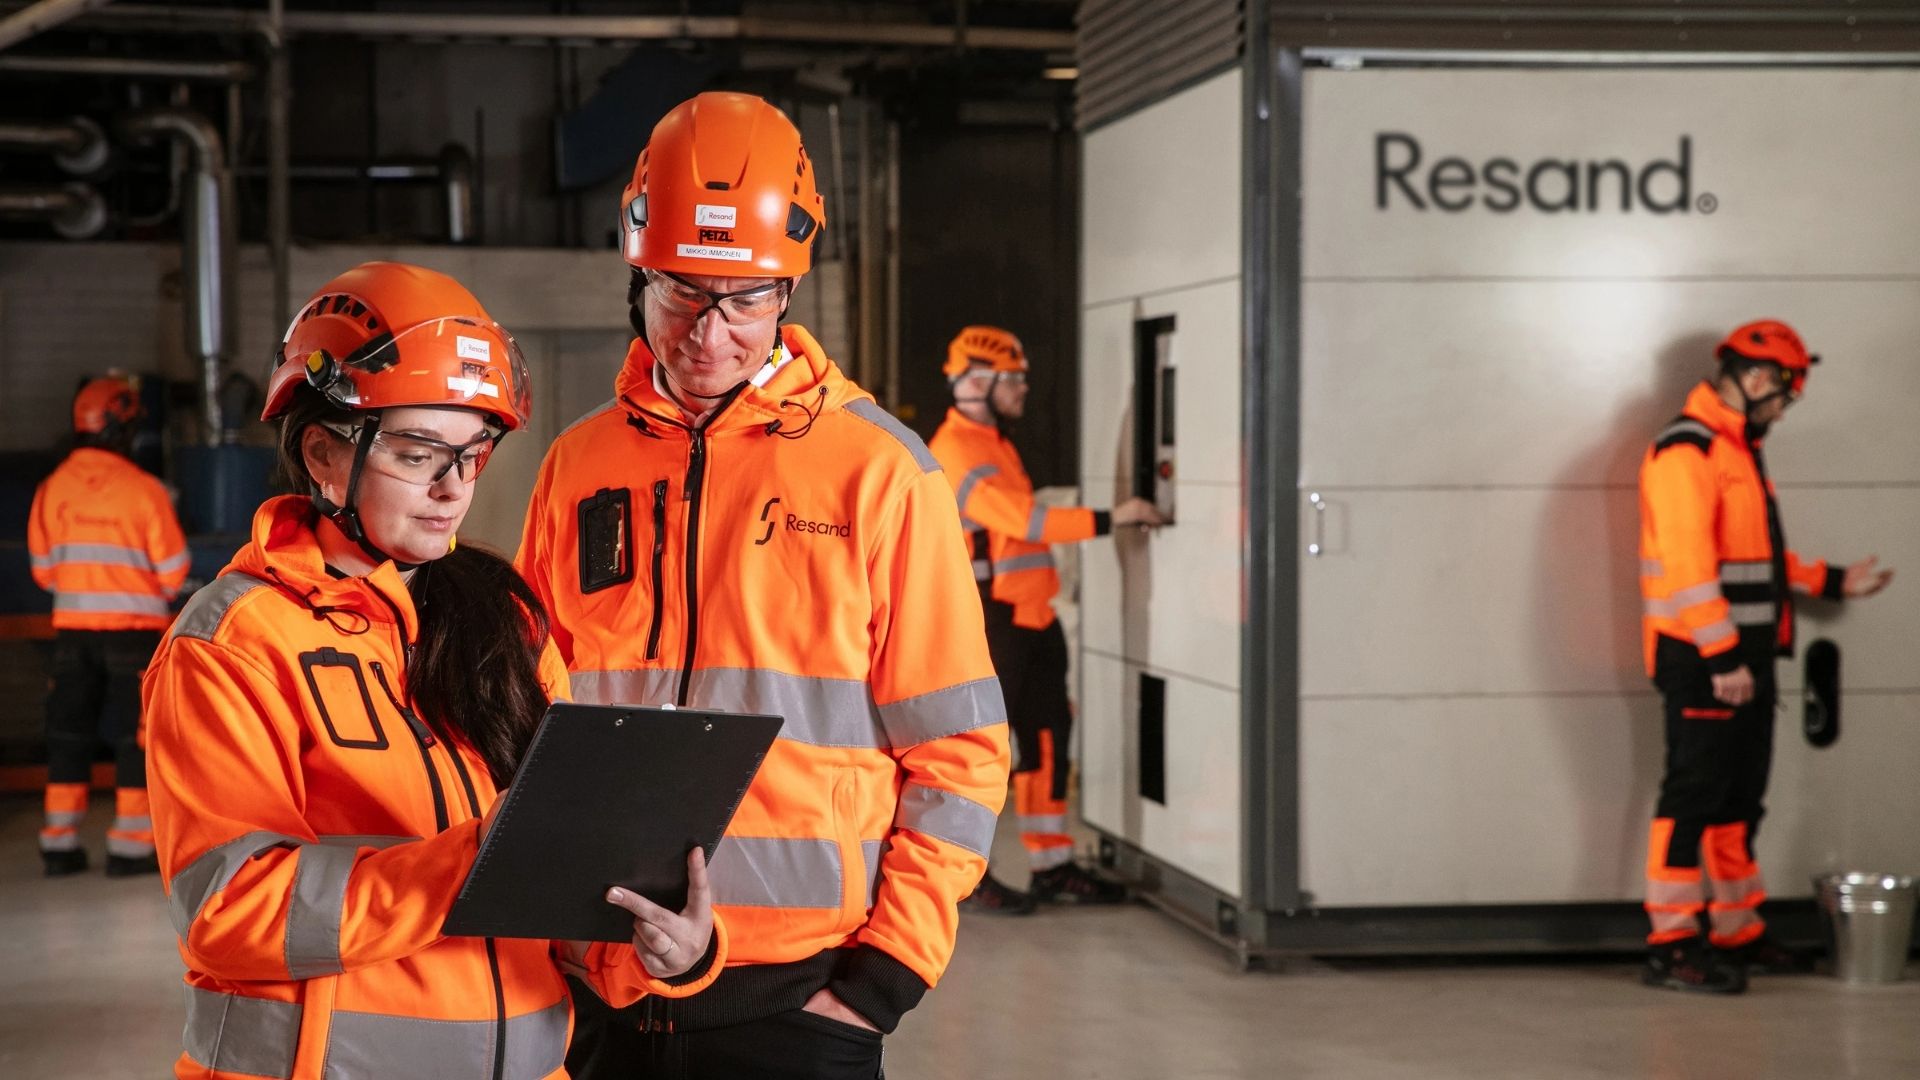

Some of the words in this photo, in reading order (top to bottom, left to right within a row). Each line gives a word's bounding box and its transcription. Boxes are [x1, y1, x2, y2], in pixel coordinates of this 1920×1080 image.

[708, 211, 733, 221] Resand
[698, 229, 735, 245] PETZL
[685, 247, 707, 256] MIKKO
[709, 249, 741, 258] IMMONEN
[785, 513, 851, 538] Resand
